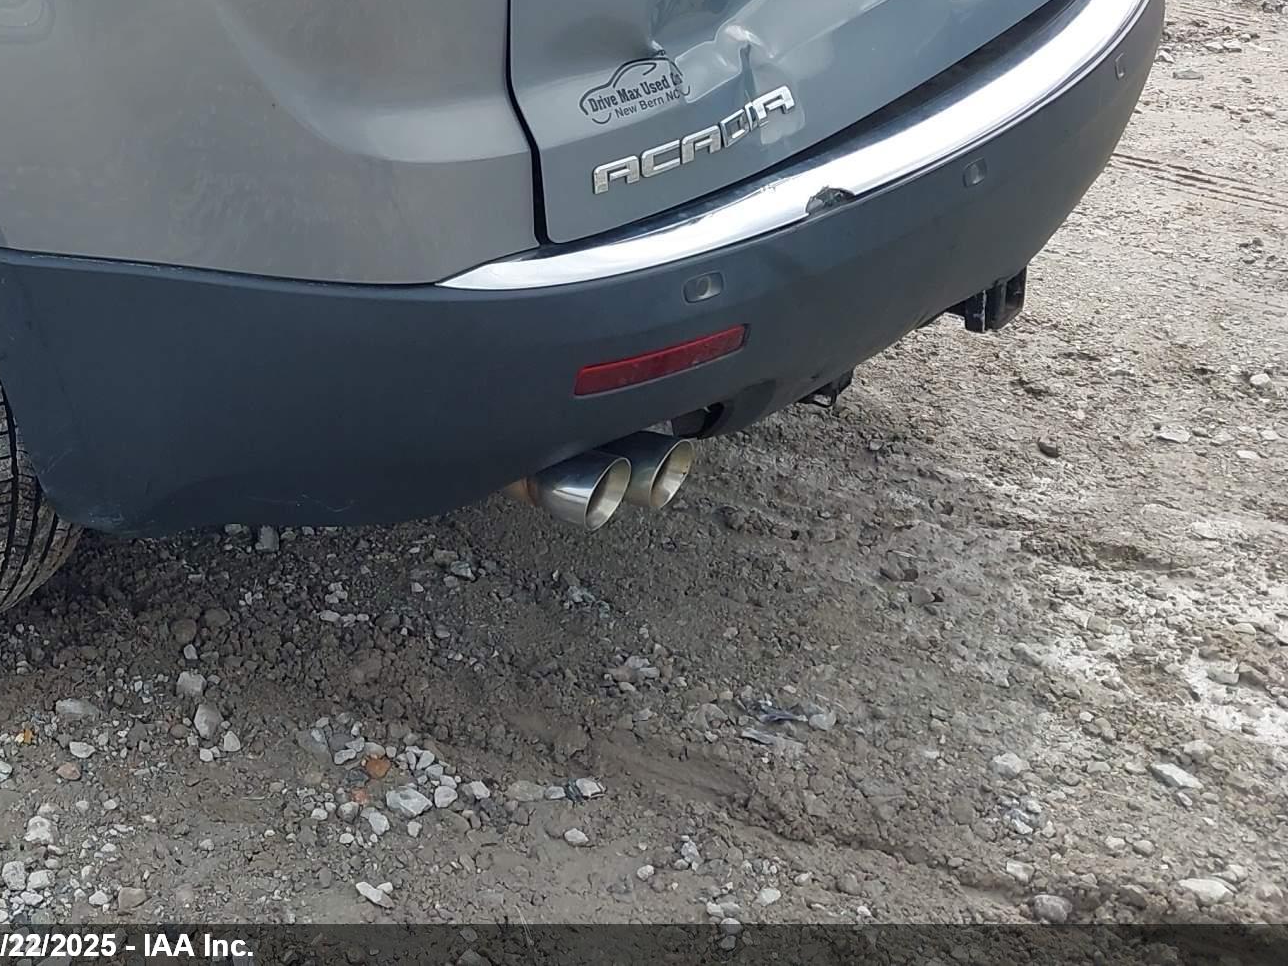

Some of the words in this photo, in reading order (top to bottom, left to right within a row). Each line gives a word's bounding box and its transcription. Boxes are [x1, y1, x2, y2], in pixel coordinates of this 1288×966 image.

[587, 94, 619, 113] Drive
[615, 87, 642, 104] Max
[639, 74, 671, 96] Used
[614, 105, 638, 119] New
[638, 97, 665, 111] Bern
[665, 89, 681, 102] NC
[593, 85, 795, 195] ACADIA
